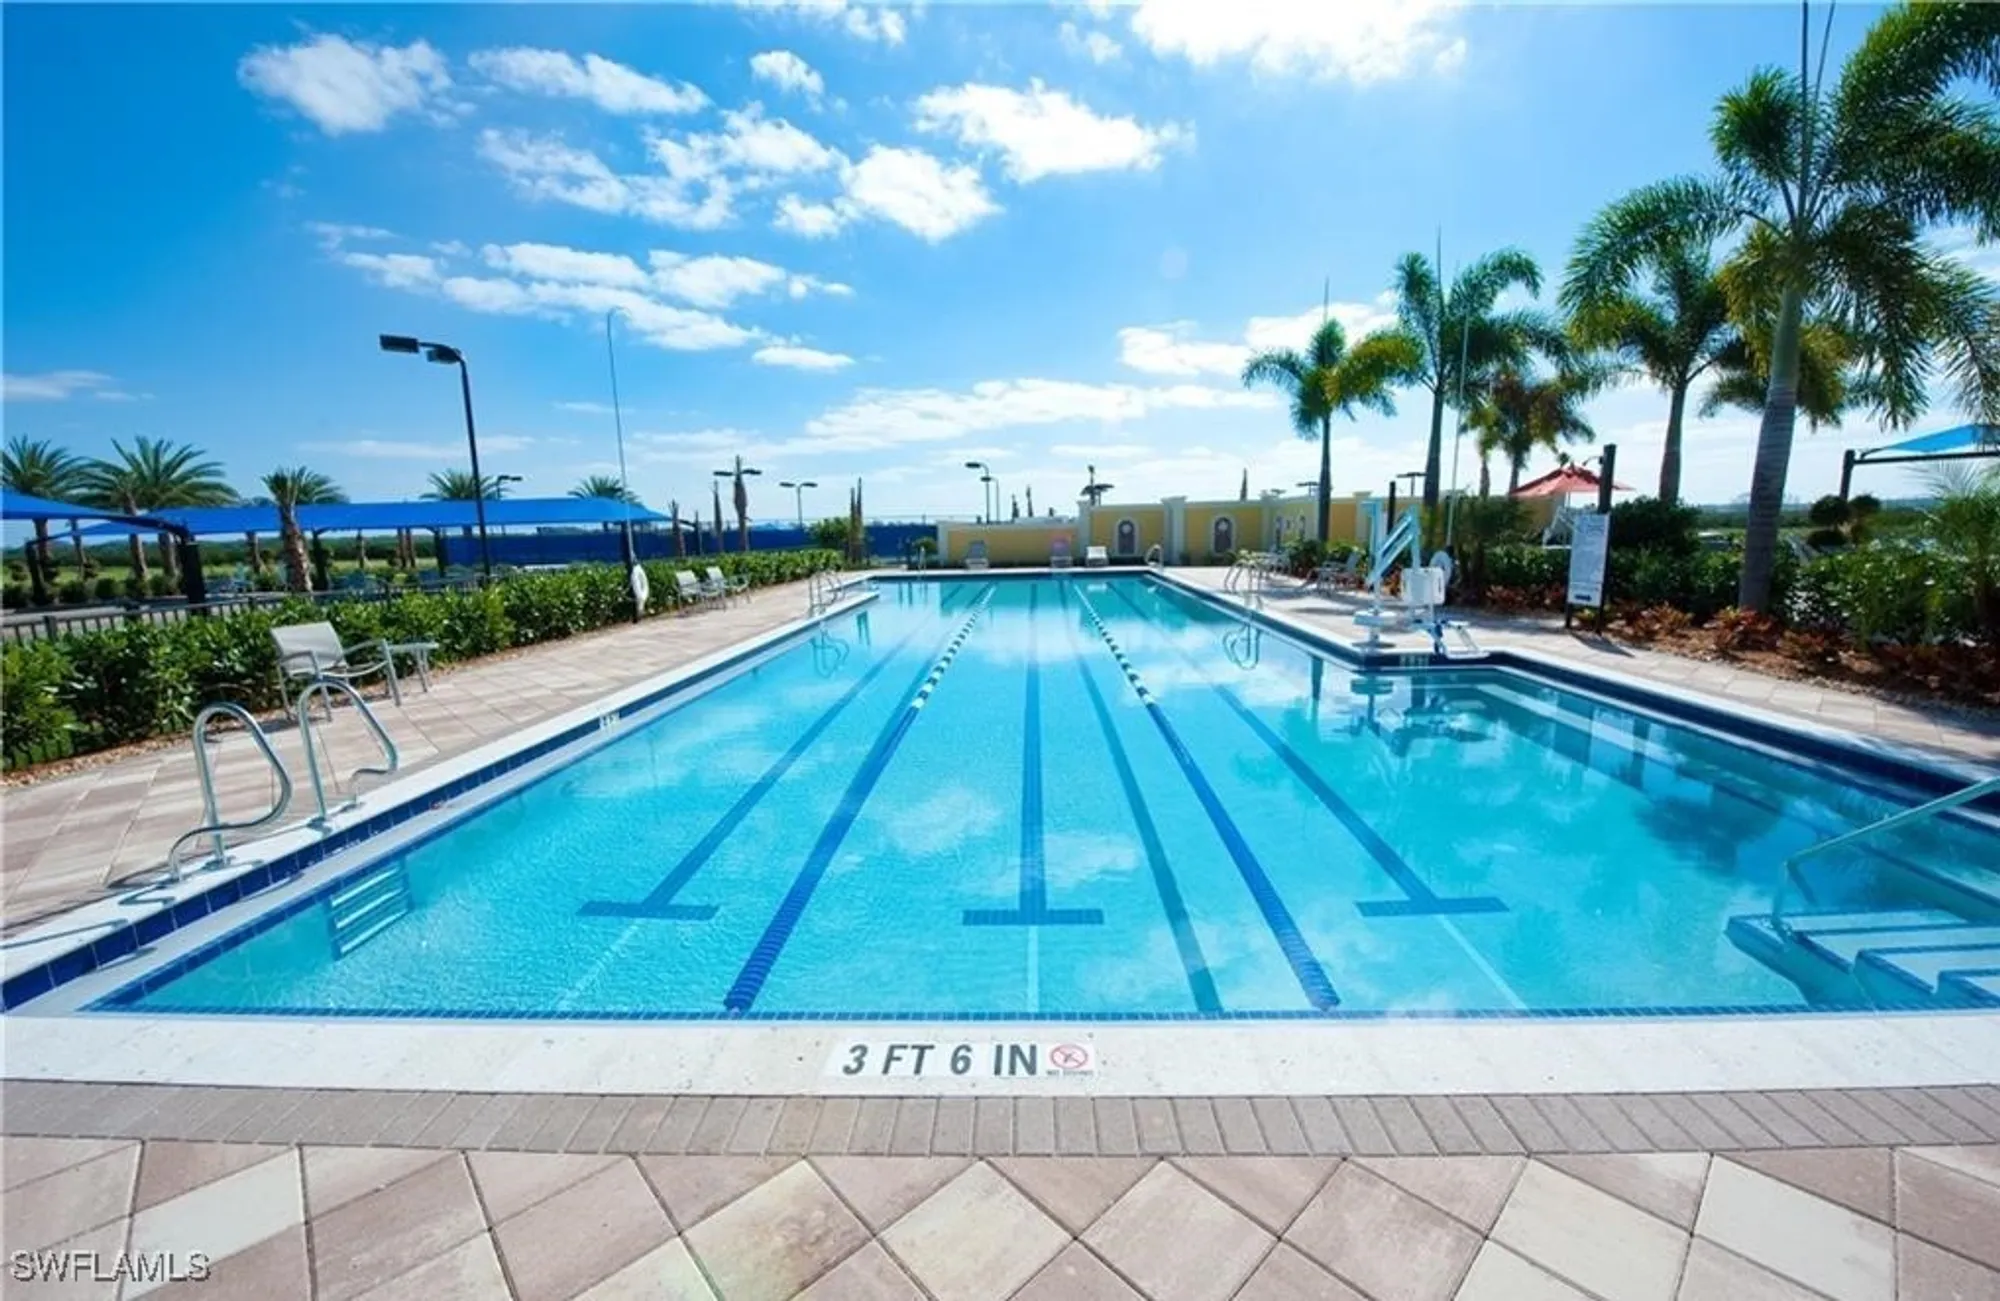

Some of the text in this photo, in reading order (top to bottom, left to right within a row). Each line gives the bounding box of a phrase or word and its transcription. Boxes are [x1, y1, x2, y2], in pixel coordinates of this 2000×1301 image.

[842, 1044, 1037, 1076] 3 FT 6 IN
